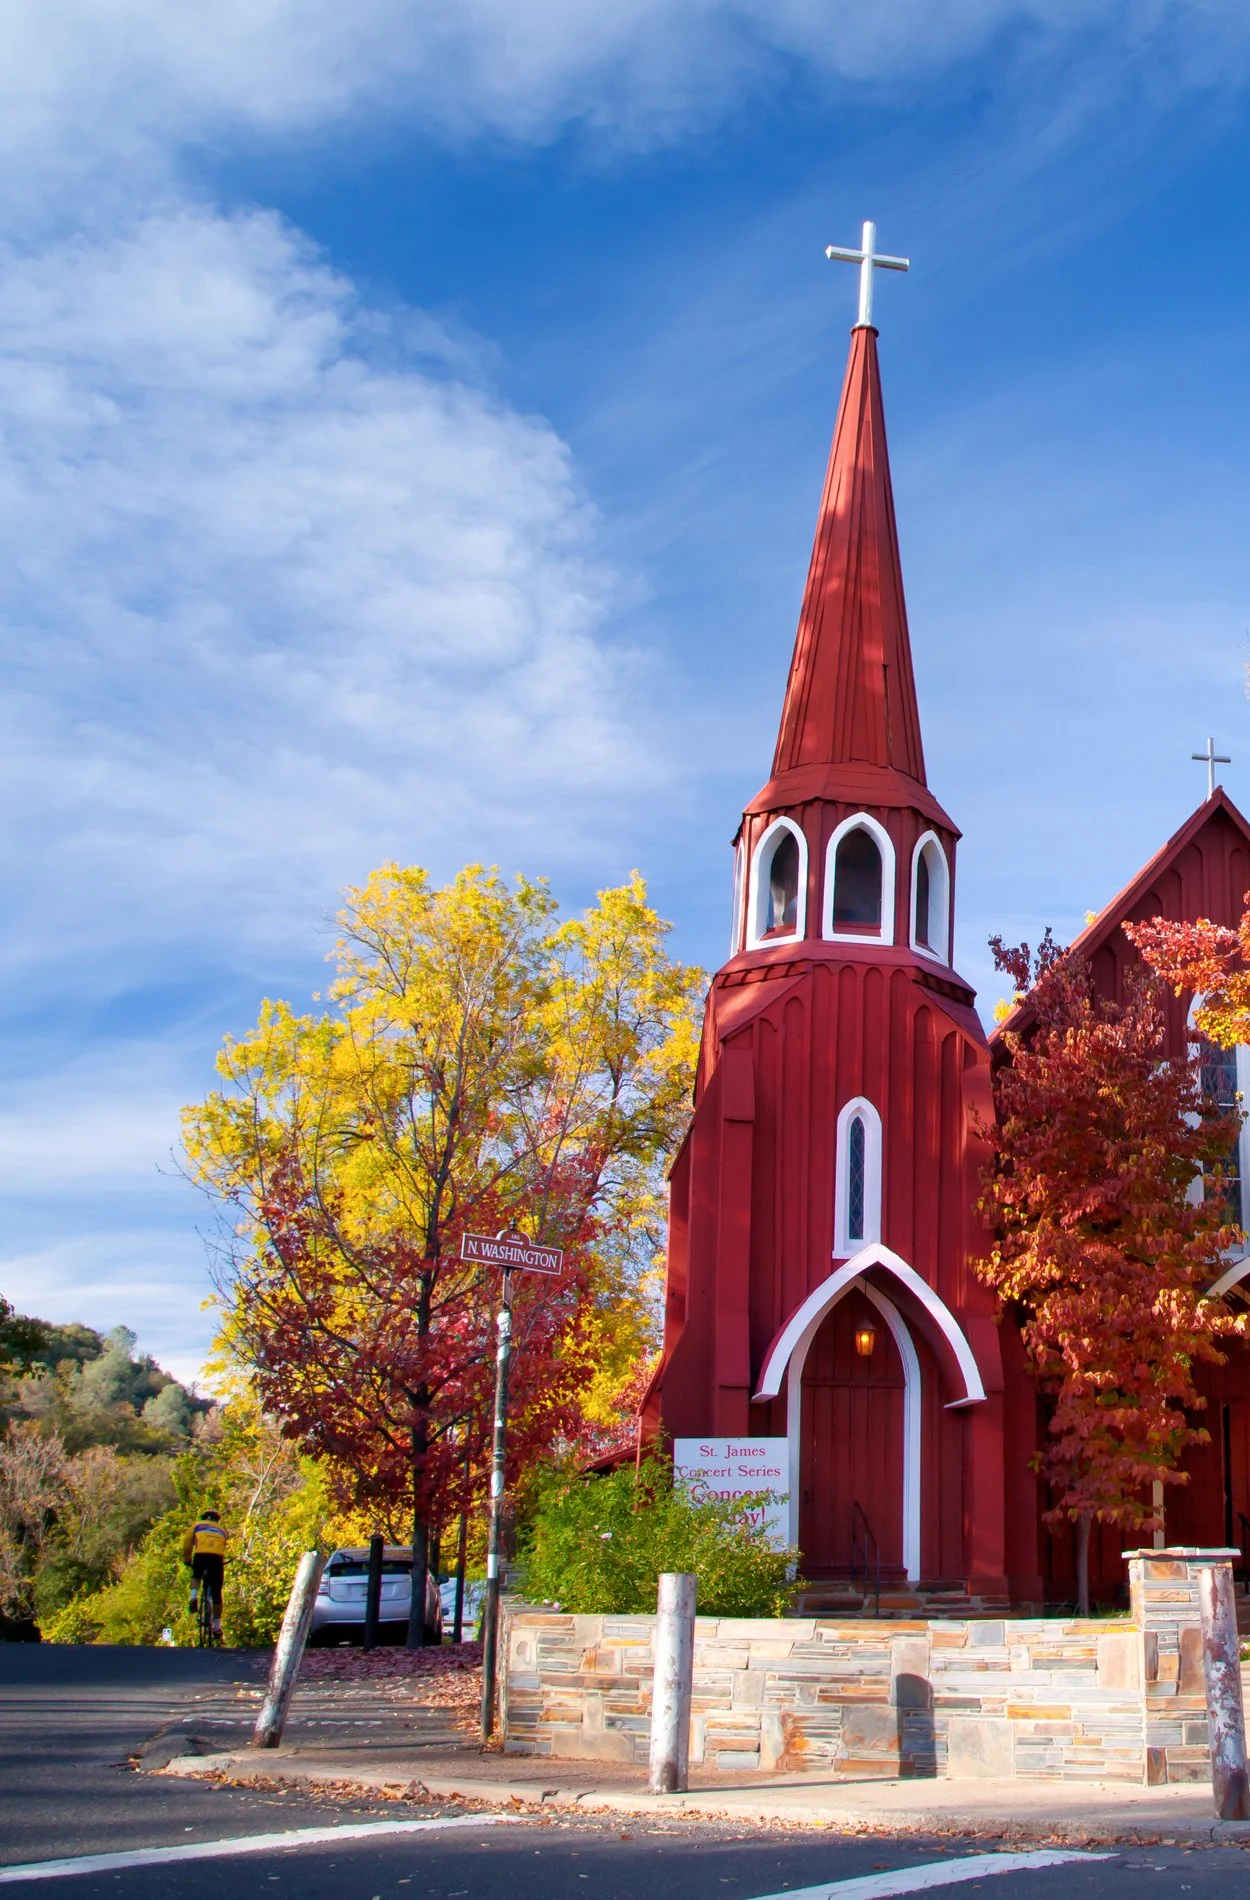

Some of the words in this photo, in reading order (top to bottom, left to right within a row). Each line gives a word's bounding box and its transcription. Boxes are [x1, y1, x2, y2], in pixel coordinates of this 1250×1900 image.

[467, 1240, 478, 1255] N.
[481, 1242, 558, 1268] WASHINGTON
[699, 1445, 718, 1457] St.
[724, 1444, 766, 1459] James
[679, 1465, 732, 1478] Concert
[738, 1465, 781, 1477] Series
